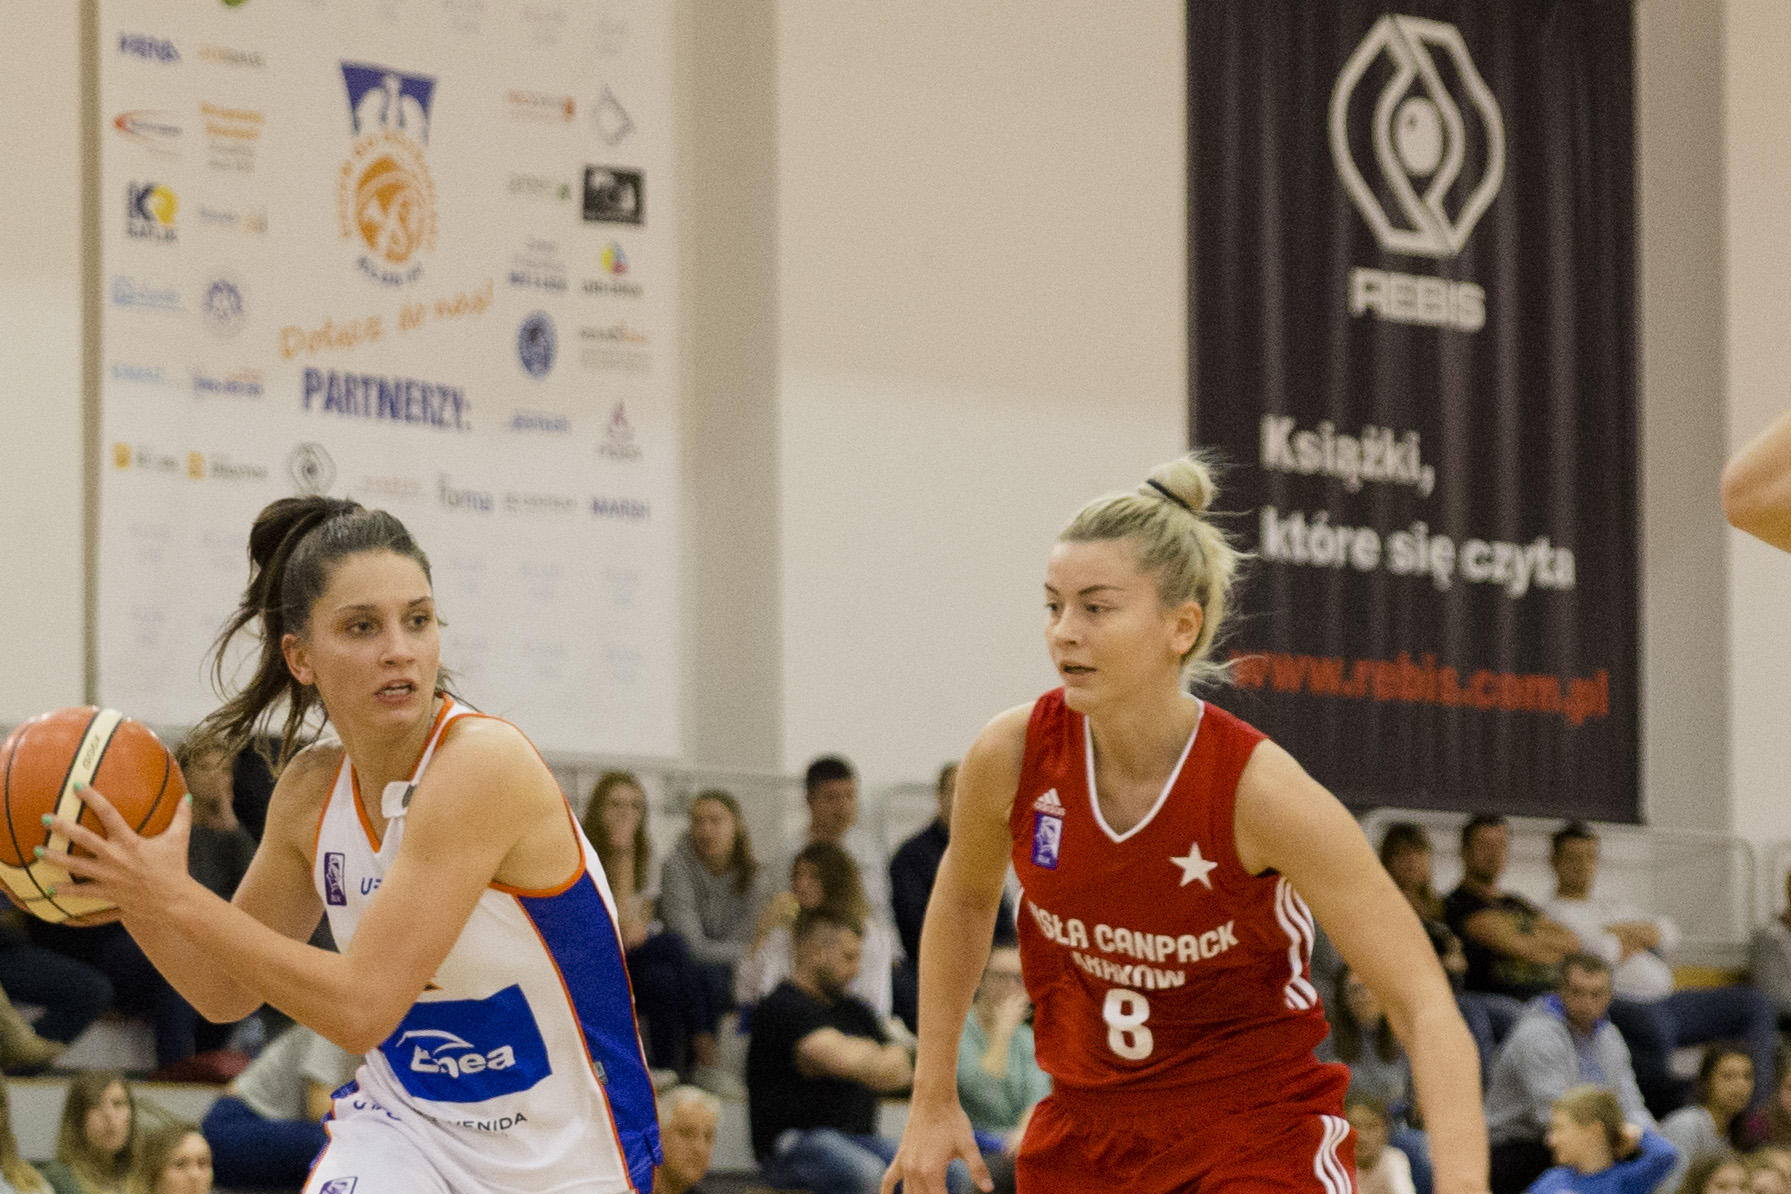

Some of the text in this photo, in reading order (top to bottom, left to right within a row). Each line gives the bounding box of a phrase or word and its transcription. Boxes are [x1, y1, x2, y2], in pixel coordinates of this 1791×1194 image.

[1350, 266, 1486, 334] REBIS
[1260, 413, 1435, 498] Książki,
[1260, 505, 1577, 600] które się czyta
[1094, 913, 1240, 963] CANPACK
[1102, 987, 1155, 1061] 8
